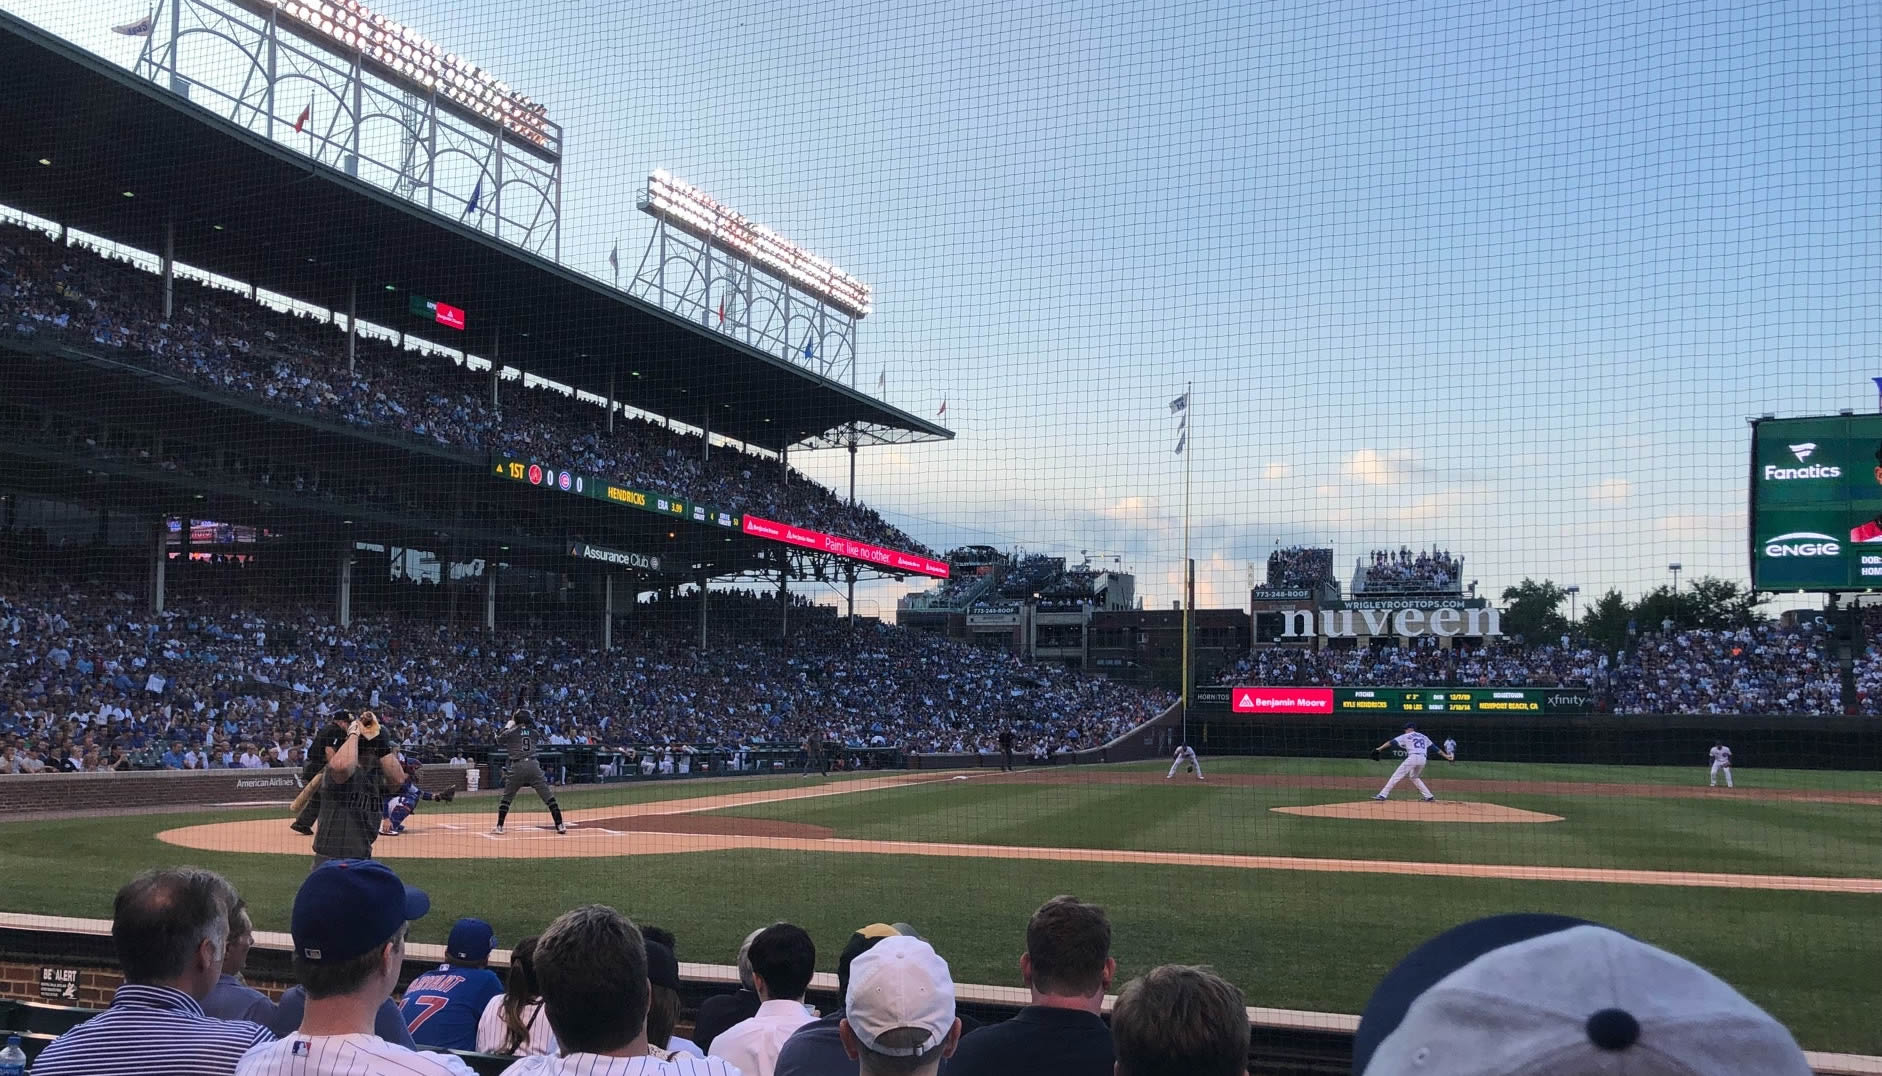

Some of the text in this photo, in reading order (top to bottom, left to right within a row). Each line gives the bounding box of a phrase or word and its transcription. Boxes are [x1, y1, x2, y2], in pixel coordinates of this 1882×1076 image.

[509, 462, 583, 492] 1ST 0 0
[1765, 464, 1841, 480] Fanatics
[608, 486, 645, 506] HENDRICKS
[657, 499, 668, 511] ERA
[825, 537, 844, 553] Paint
[846, 541, 859, 555] like
[860, 548, 870, 558] no
[583, 545, 649, 568] Assurance Club
[1344, 600, 1465, 609] WRIGLEYROOFTOPS.COM
[1281, 607, 1504, 638] nuveen
[1255, 697, 1327, 708] Benjamin Moore
[1548, 695, 1585, 706] xfinity
[522, 737, 531, 751] 9
[237, 780, 269, 788] American
[43, 968, 77, 982] BE ALERT
